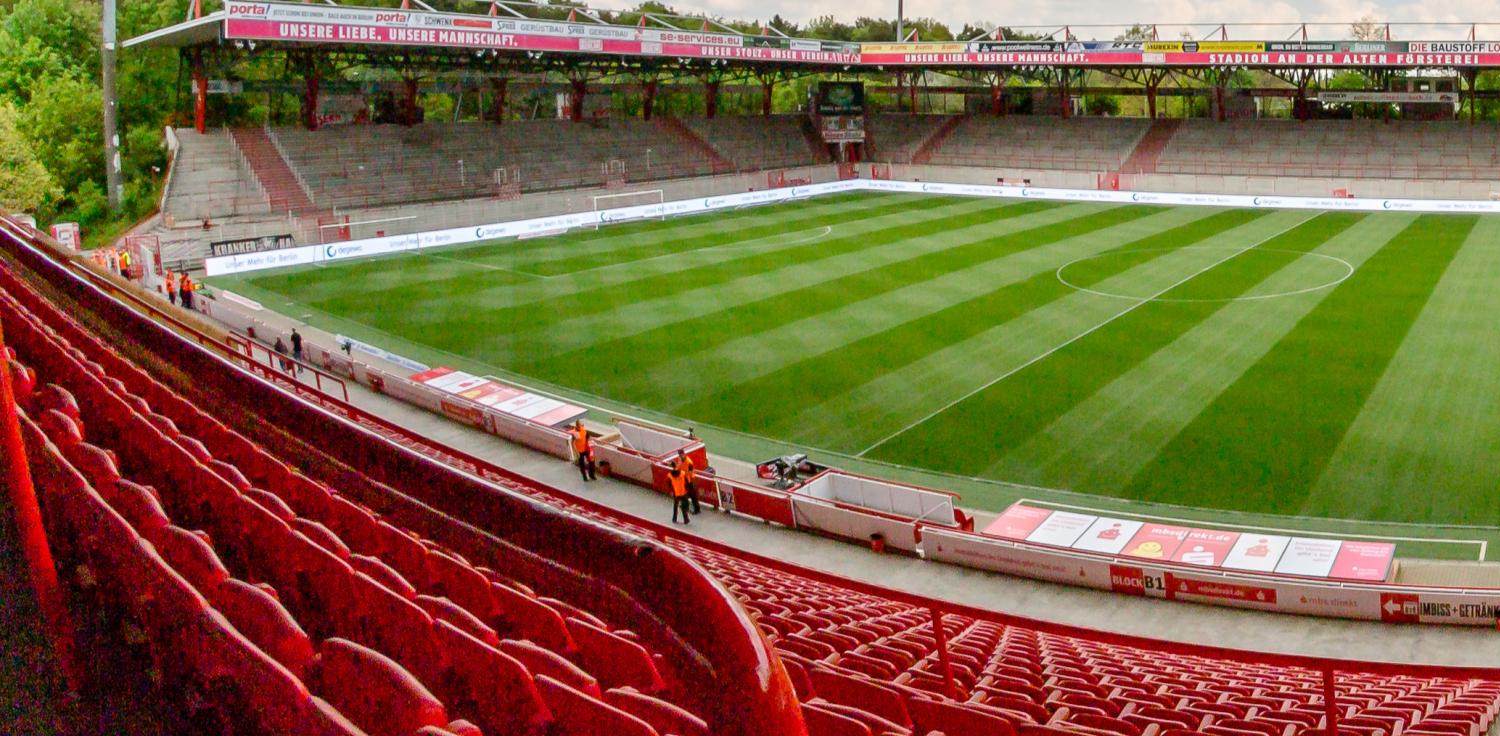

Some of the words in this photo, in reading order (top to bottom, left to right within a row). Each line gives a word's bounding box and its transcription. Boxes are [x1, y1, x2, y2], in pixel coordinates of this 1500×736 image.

[230, 4, 271, 18] porta!
[376, 13, 411, 26] porta!
[280, 23, 333, 38] UNSERE
[339, 26, 382, 40] LIEBE.
[389, 28, 436, 43] UNSERE
[439, 31, 518, 47] MANNSCHAFT.
[521, 23, 563, 34] GERÜSTBAU
[589, 29, 628, 38] GERÜSTBAU
[701, 46, 731, 57] UNSER
[736, 48, 766, 59] STOLZ.
[771, 50, 796, 60] UNSER
[802, 51, 832, 62] VEREIN.
[1410, 44, 1427, 52] DIE
[1431, 44, 1485, 52] BAUSTOFF
[905, 53, 943, 63] UNSERE
[949, 53, 973, 63] LIEBE.
[977, 54, 1014, 63] UNSERE
[1018, 53, 1089, 63] MANNSCHAFT.
[1209, 54, 1268, 63] STADION
[1277, 54, 1297, 63] AN
[1306, 54, 1334, 63] DER
[1343, 54, 1387, 64] ALTEN
[1397, 52, 1479, 64] FÖRSTEREI
[1112, 575, 1143, 588] BLOCK
[1143, 575, 1164, 590] B1
[1420, 602, 1451, 617] IMBISS
